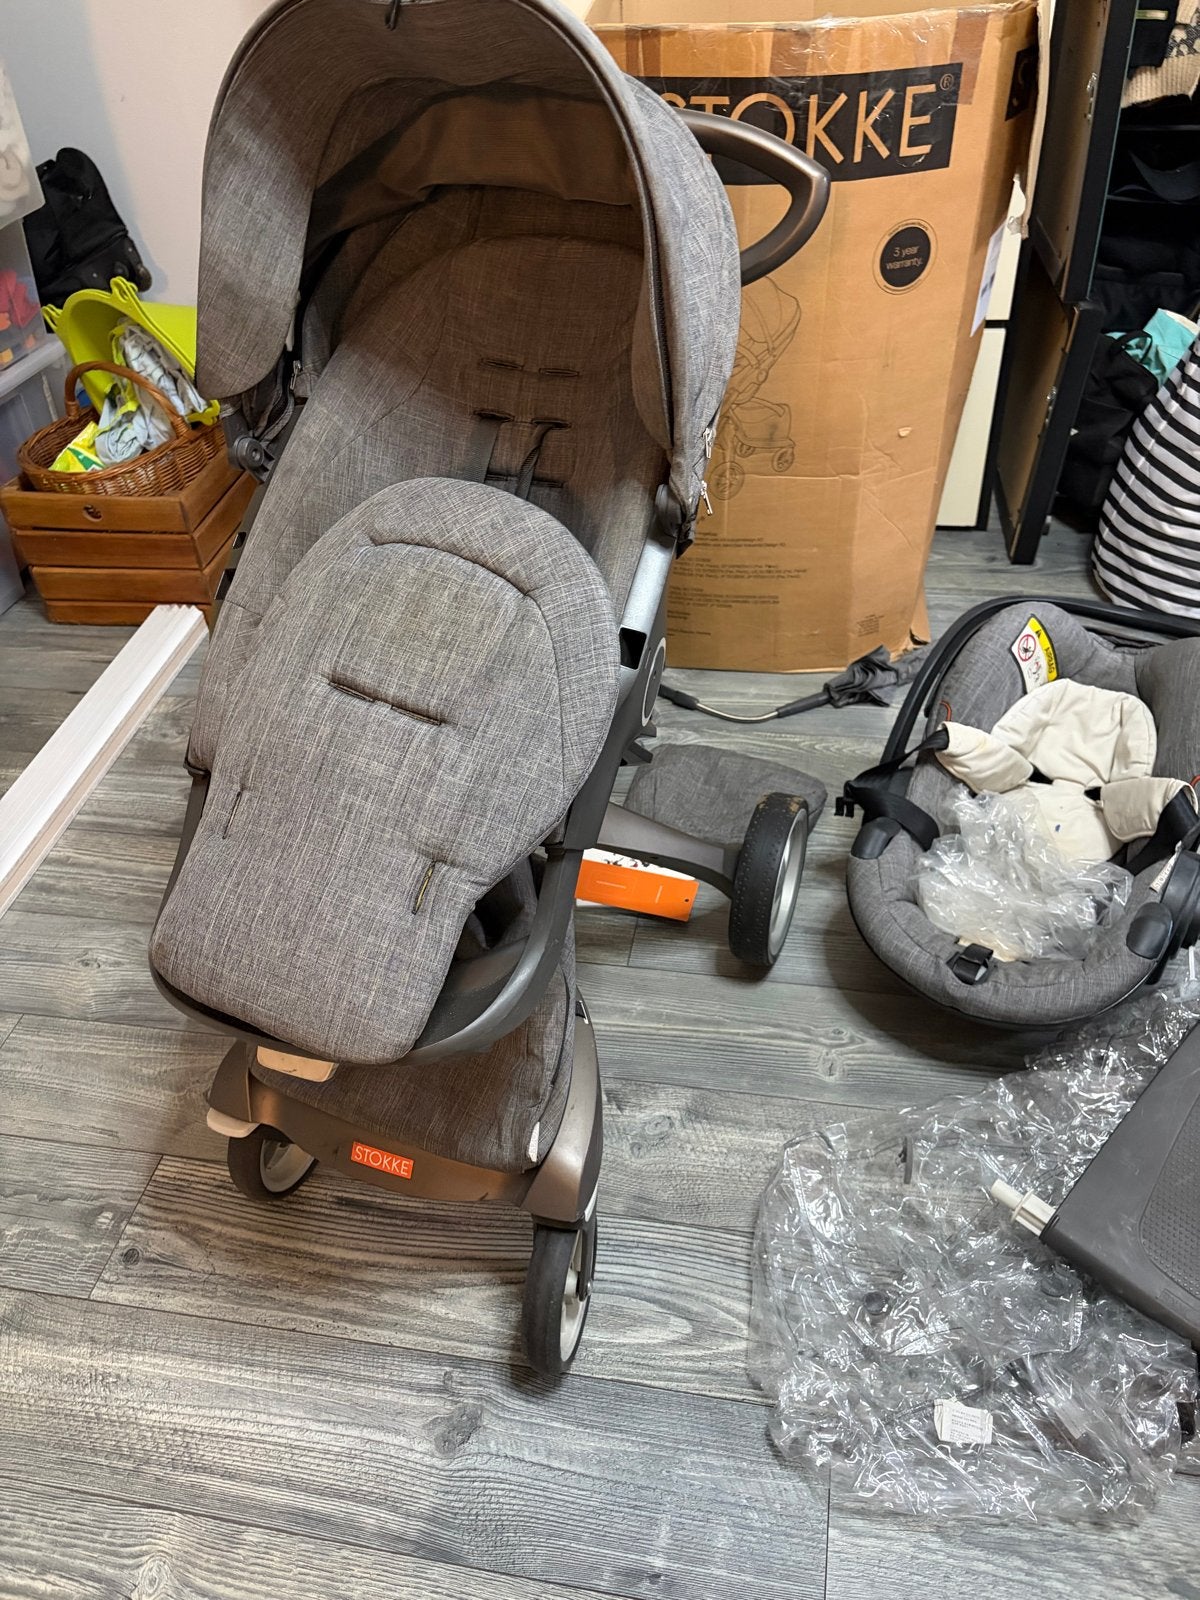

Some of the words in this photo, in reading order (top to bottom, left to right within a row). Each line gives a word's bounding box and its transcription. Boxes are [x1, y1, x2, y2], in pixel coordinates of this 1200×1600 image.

[893, 247, 900, 257] 3
[901, 246, 920, 258] year
[354, 1145, 410, 1176] STOKKE
